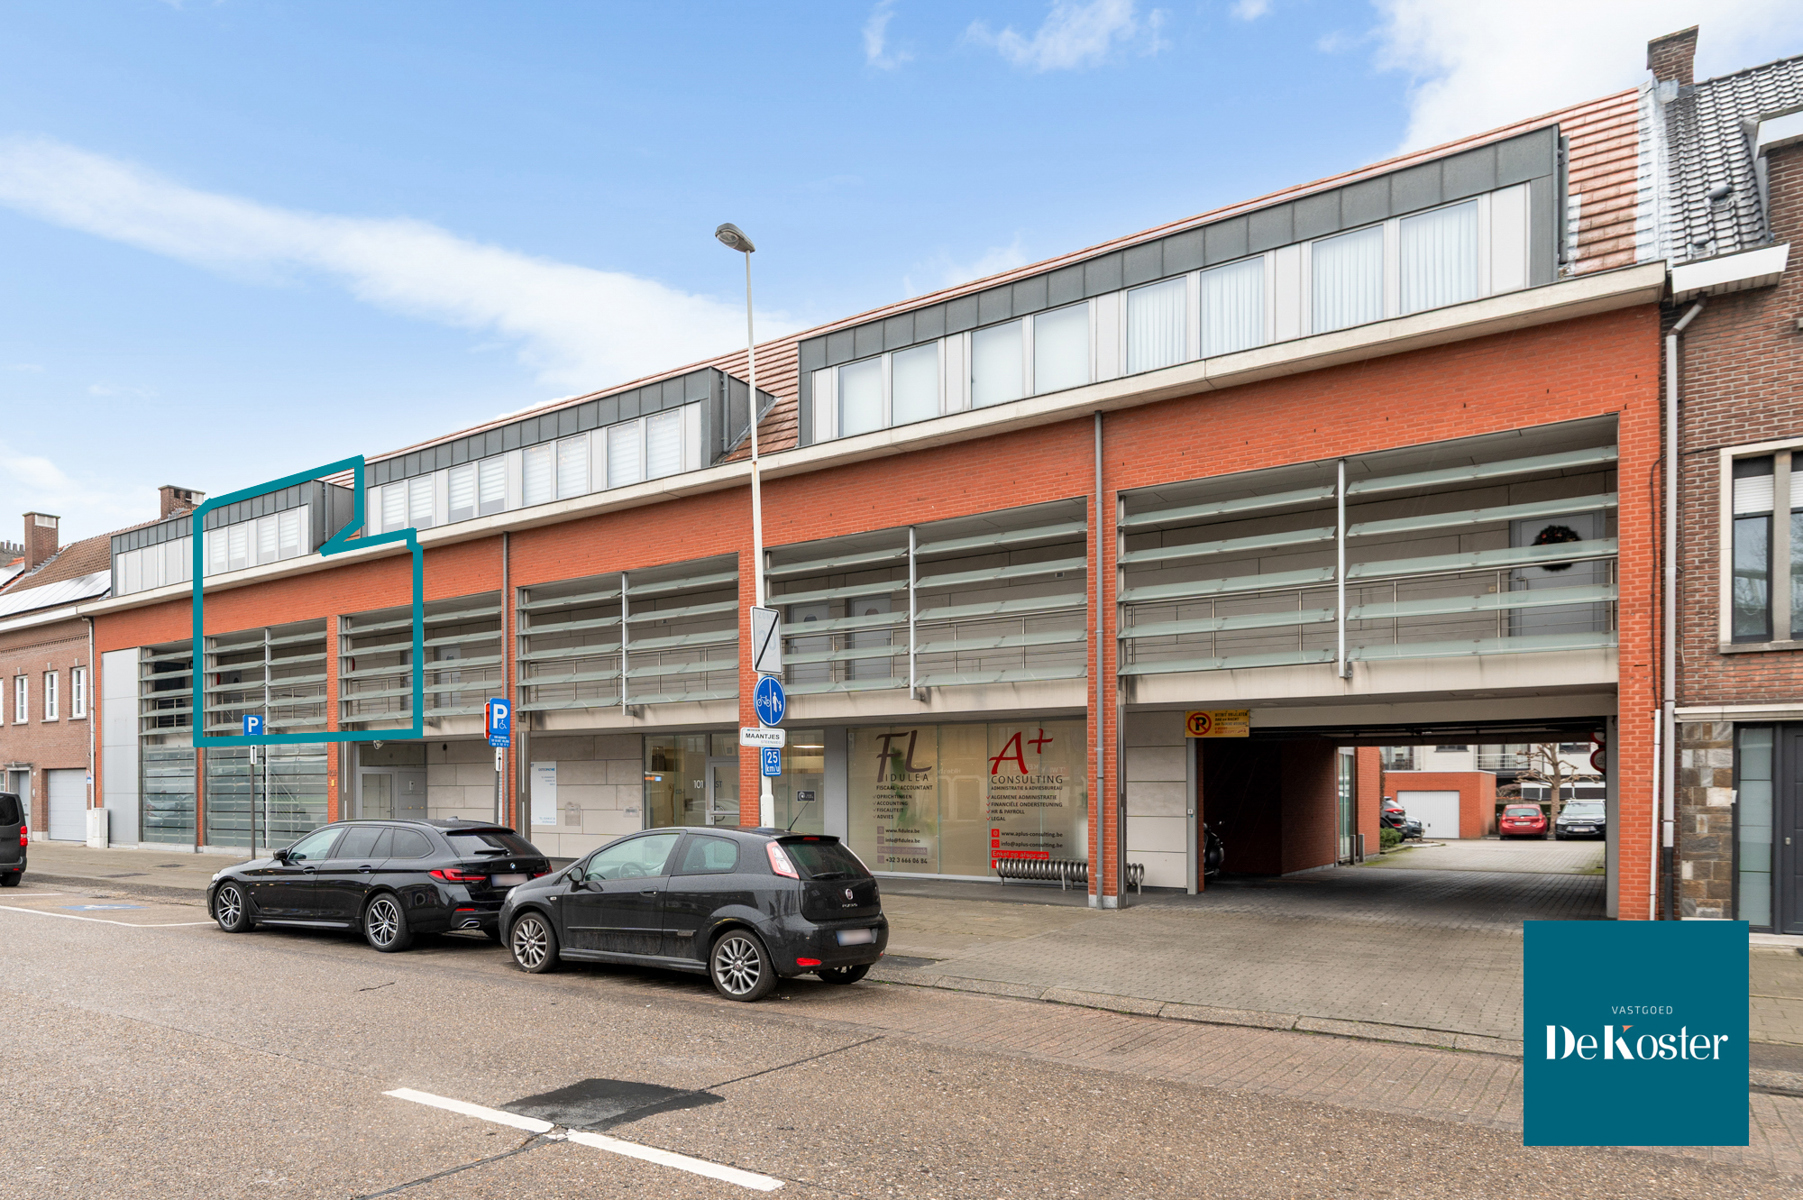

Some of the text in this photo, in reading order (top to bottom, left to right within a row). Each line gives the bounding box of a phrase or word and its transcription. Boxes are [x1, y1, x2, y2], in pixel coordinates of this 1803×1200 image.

[493, 703, 508, 729] P
[248, 717, 259, 732] P
[767, 751, 778, 764] 25
[988, 728, 1054, 775] A+
[693, 780, 704, 789] 101
[991, 775, 1063, 785] CONSULTING
[1001, 840, 1063, 849] info@aplus-consulting.be
